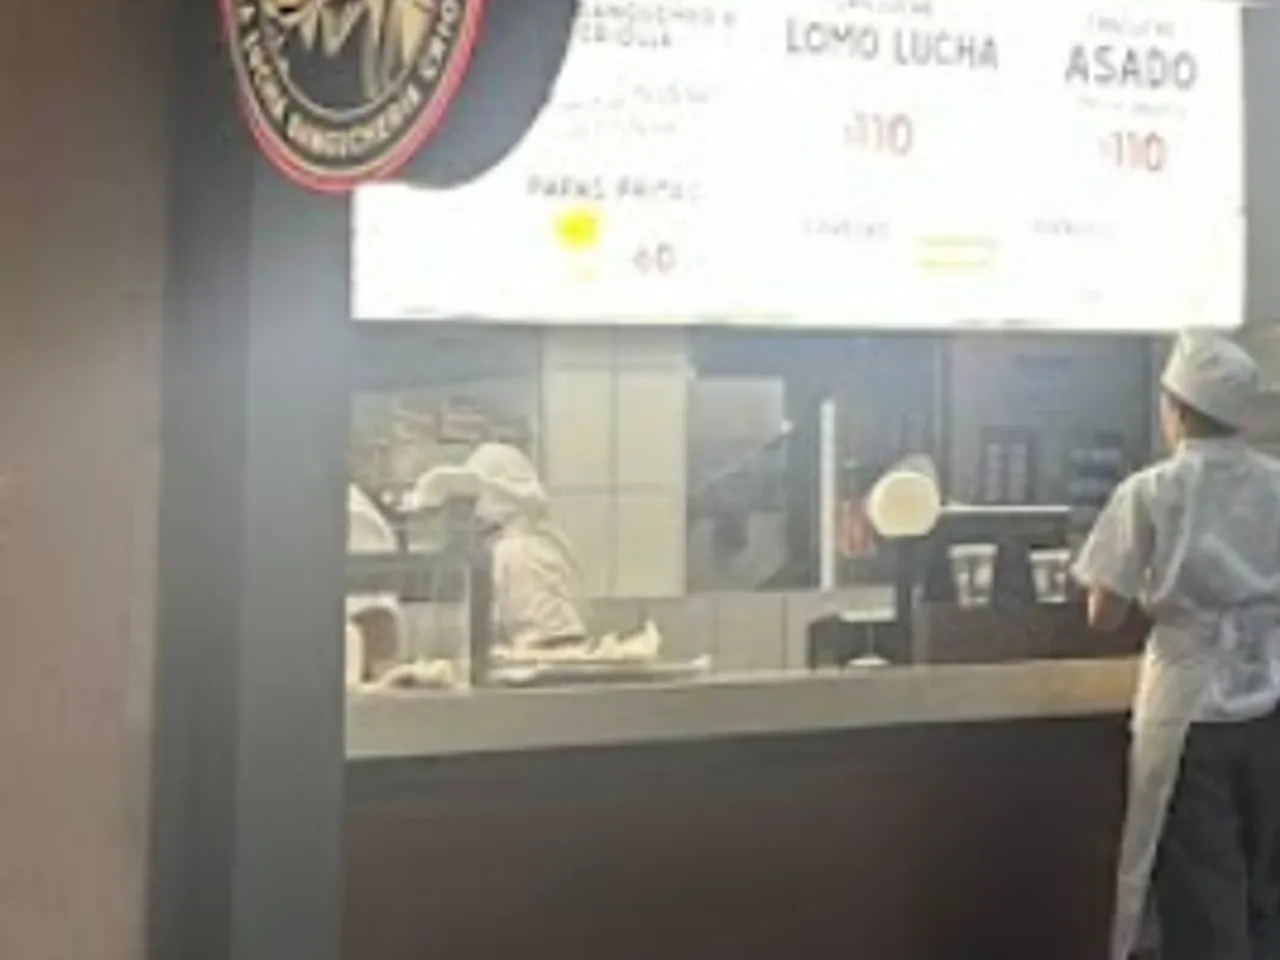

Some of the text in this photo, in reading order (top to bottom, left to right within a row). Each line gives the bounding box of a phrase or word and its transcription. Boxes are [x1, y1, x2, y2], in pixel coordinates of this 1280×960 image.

[785, 15, 1000, 71] LOMO LUCHA
[1063, 42, 1200, 93] ASADO
